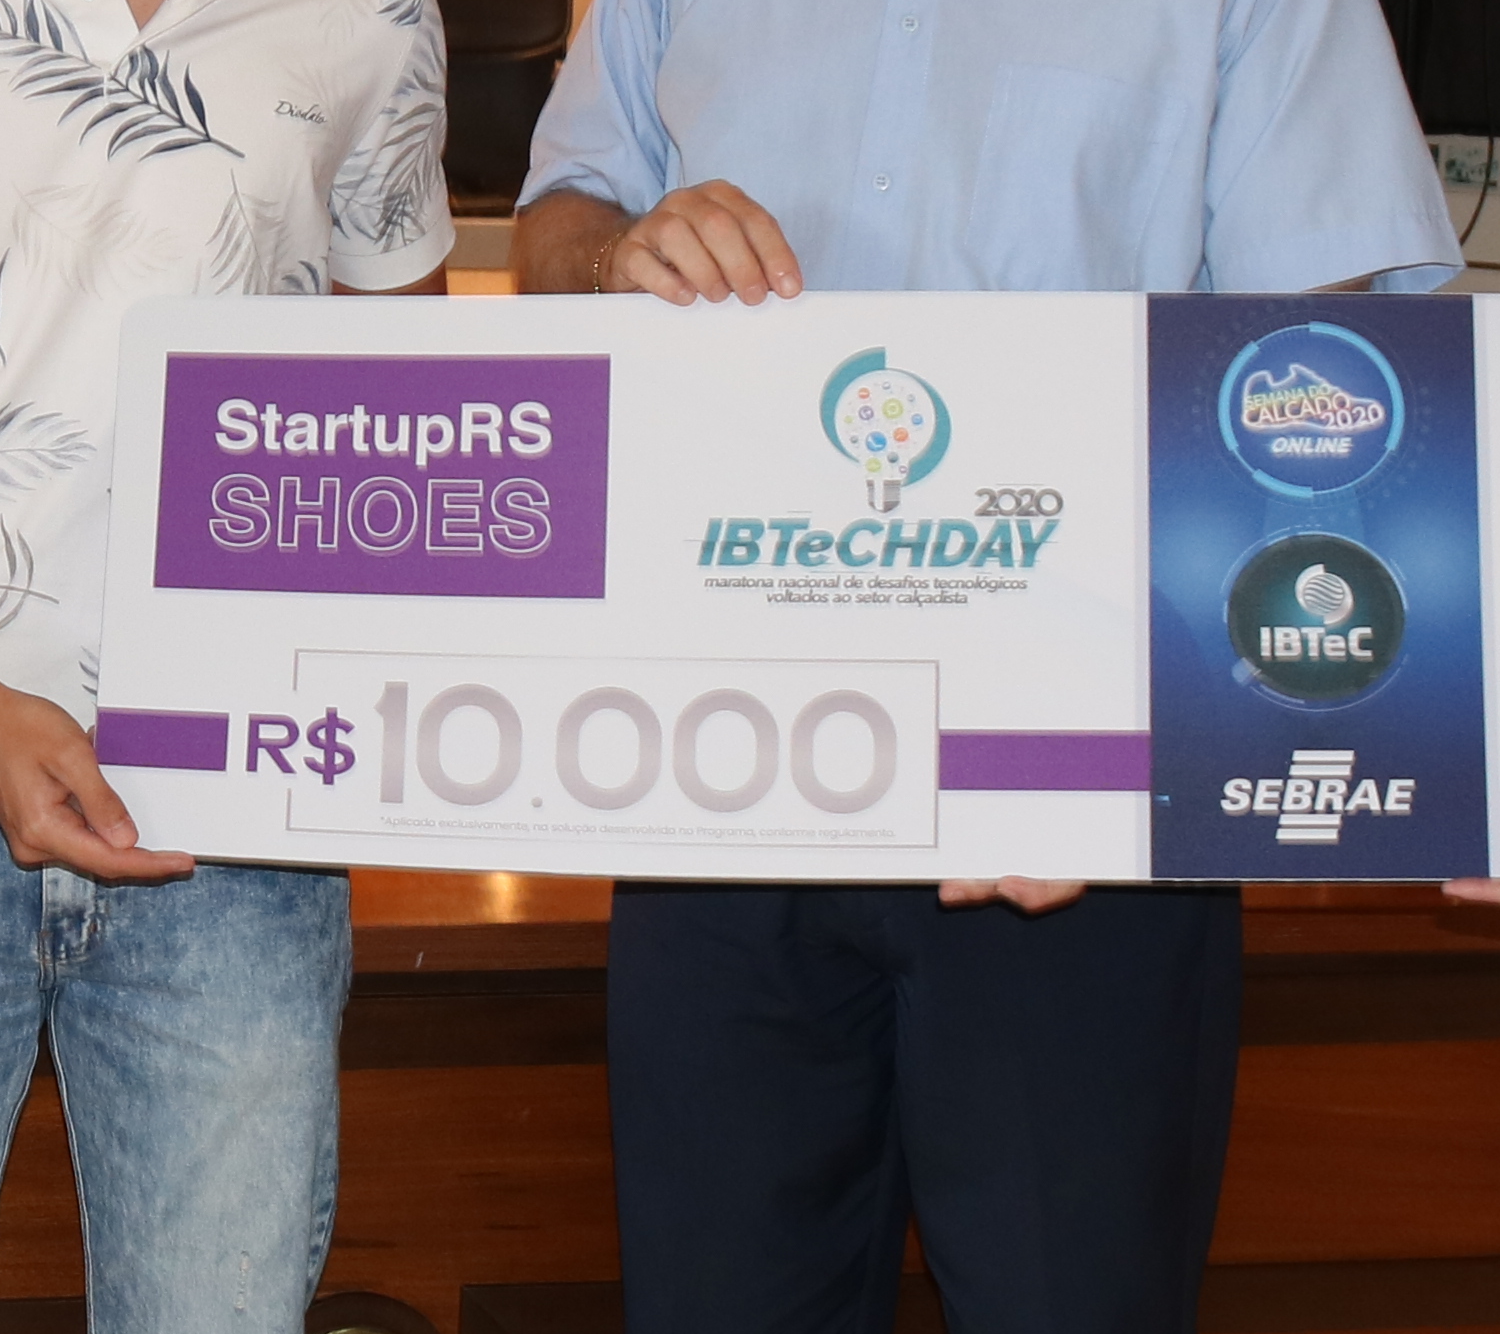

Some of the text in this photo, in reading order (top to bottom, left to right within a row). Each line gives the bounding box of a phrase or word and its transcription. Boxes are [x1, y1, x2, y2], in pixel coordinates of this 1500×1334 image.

[1246, 383, 1331, 408] SEMANA DO
[1321, 402, 1386, 430] 2020
[214, 398, 553, 469] StartupRS
[1270, 436, 1353, 455] ONLINE
[208, 473, 553, 554] SHOES
[974, 487, 1064, 517] 2020
[697, 518, 1061, 568] IBTeCHDAY
[704, 574, 1029, 593] maratona nacional de desafios tecnológicos
[766, 589, 968, 608] voltados ao setor calçadista
[1260, 626, 1374, 660] IBTeC
[245, 681, 898, 816] R$ 10.000
[1220, 778, 1416, 814] SEBRAE
[551, 821, 597, 835] solução
